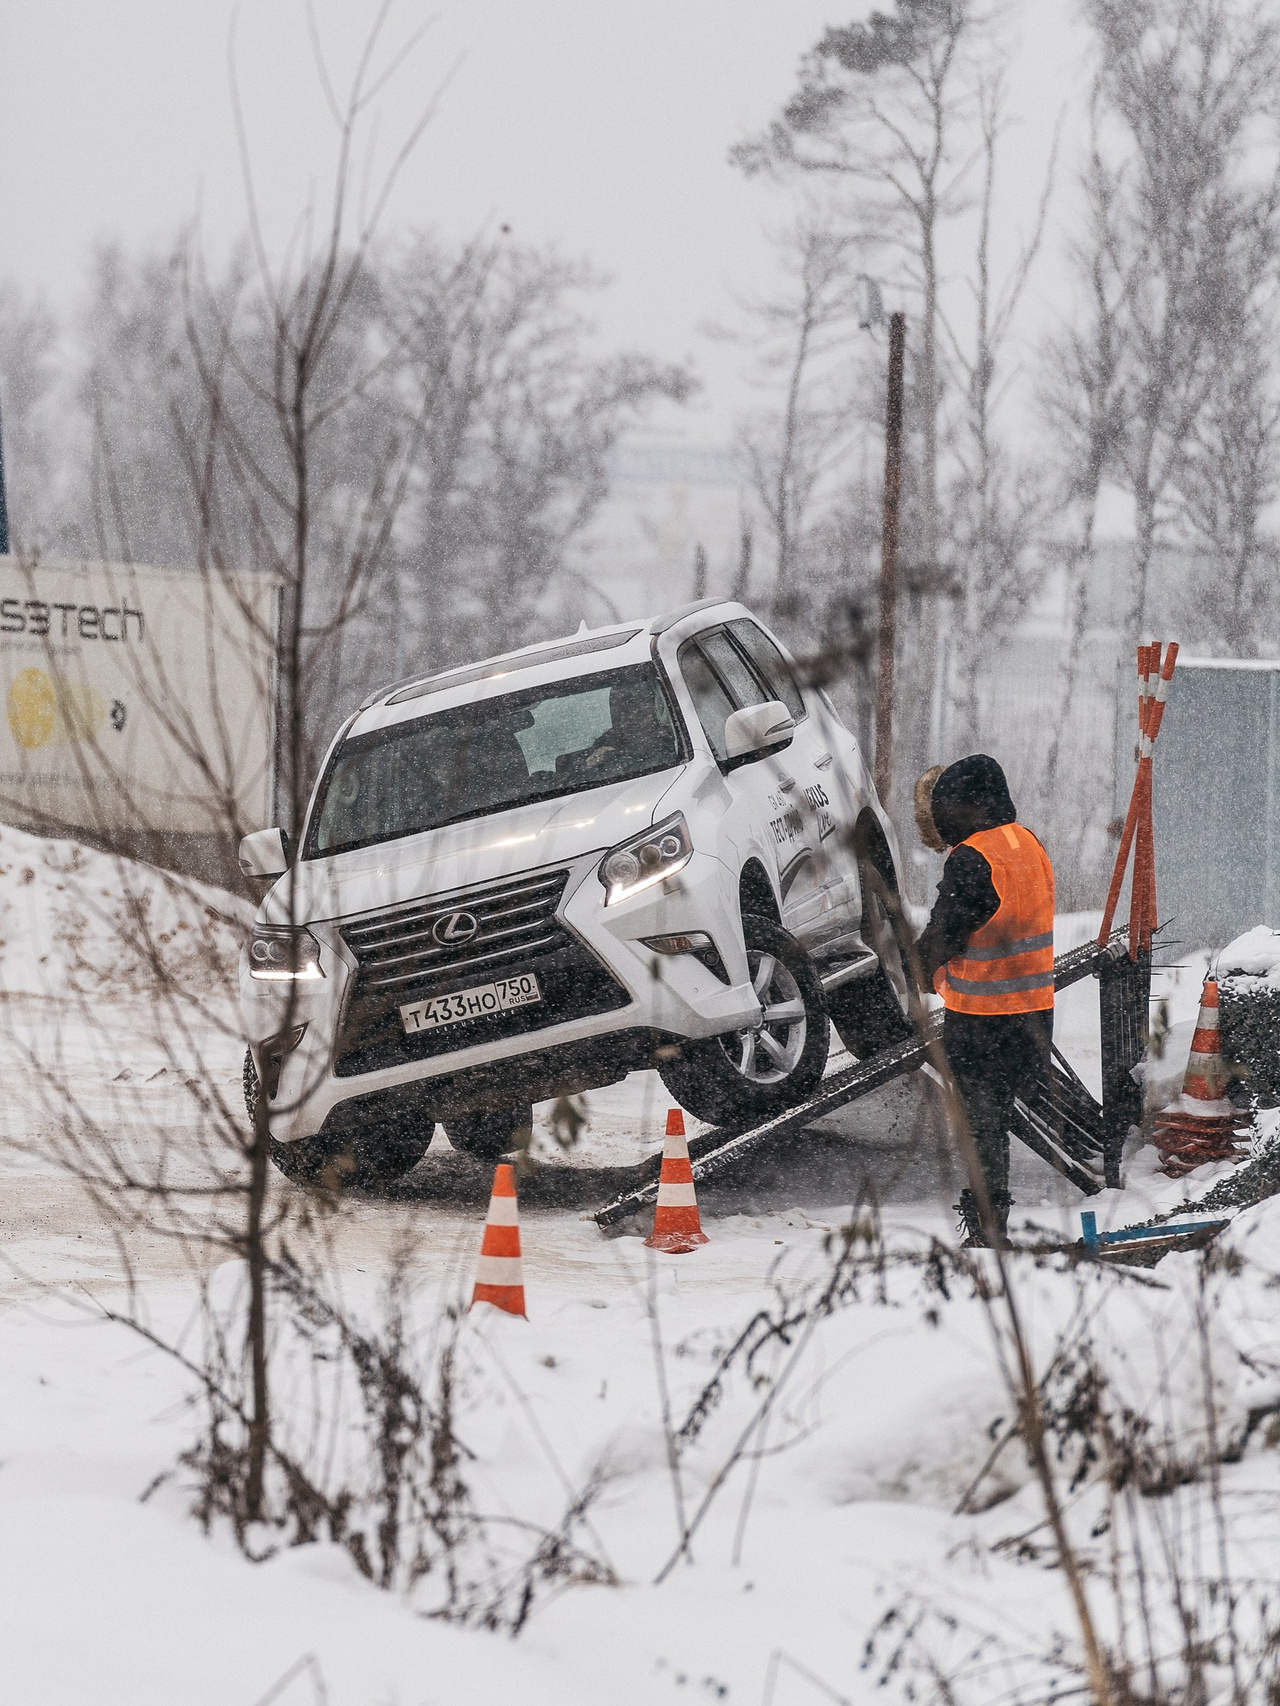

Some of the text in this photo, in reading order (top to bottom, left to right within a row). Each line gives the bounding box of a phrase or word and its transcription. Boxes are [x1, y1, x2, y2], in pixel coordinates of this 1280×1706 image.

[803, 783, 829, 811] LEXUS
[496, 977, 531, 1000] 750
[509, 995, 527, 1005] RUS
[436, 1009, 516, 1034] LEXUS LIVE
